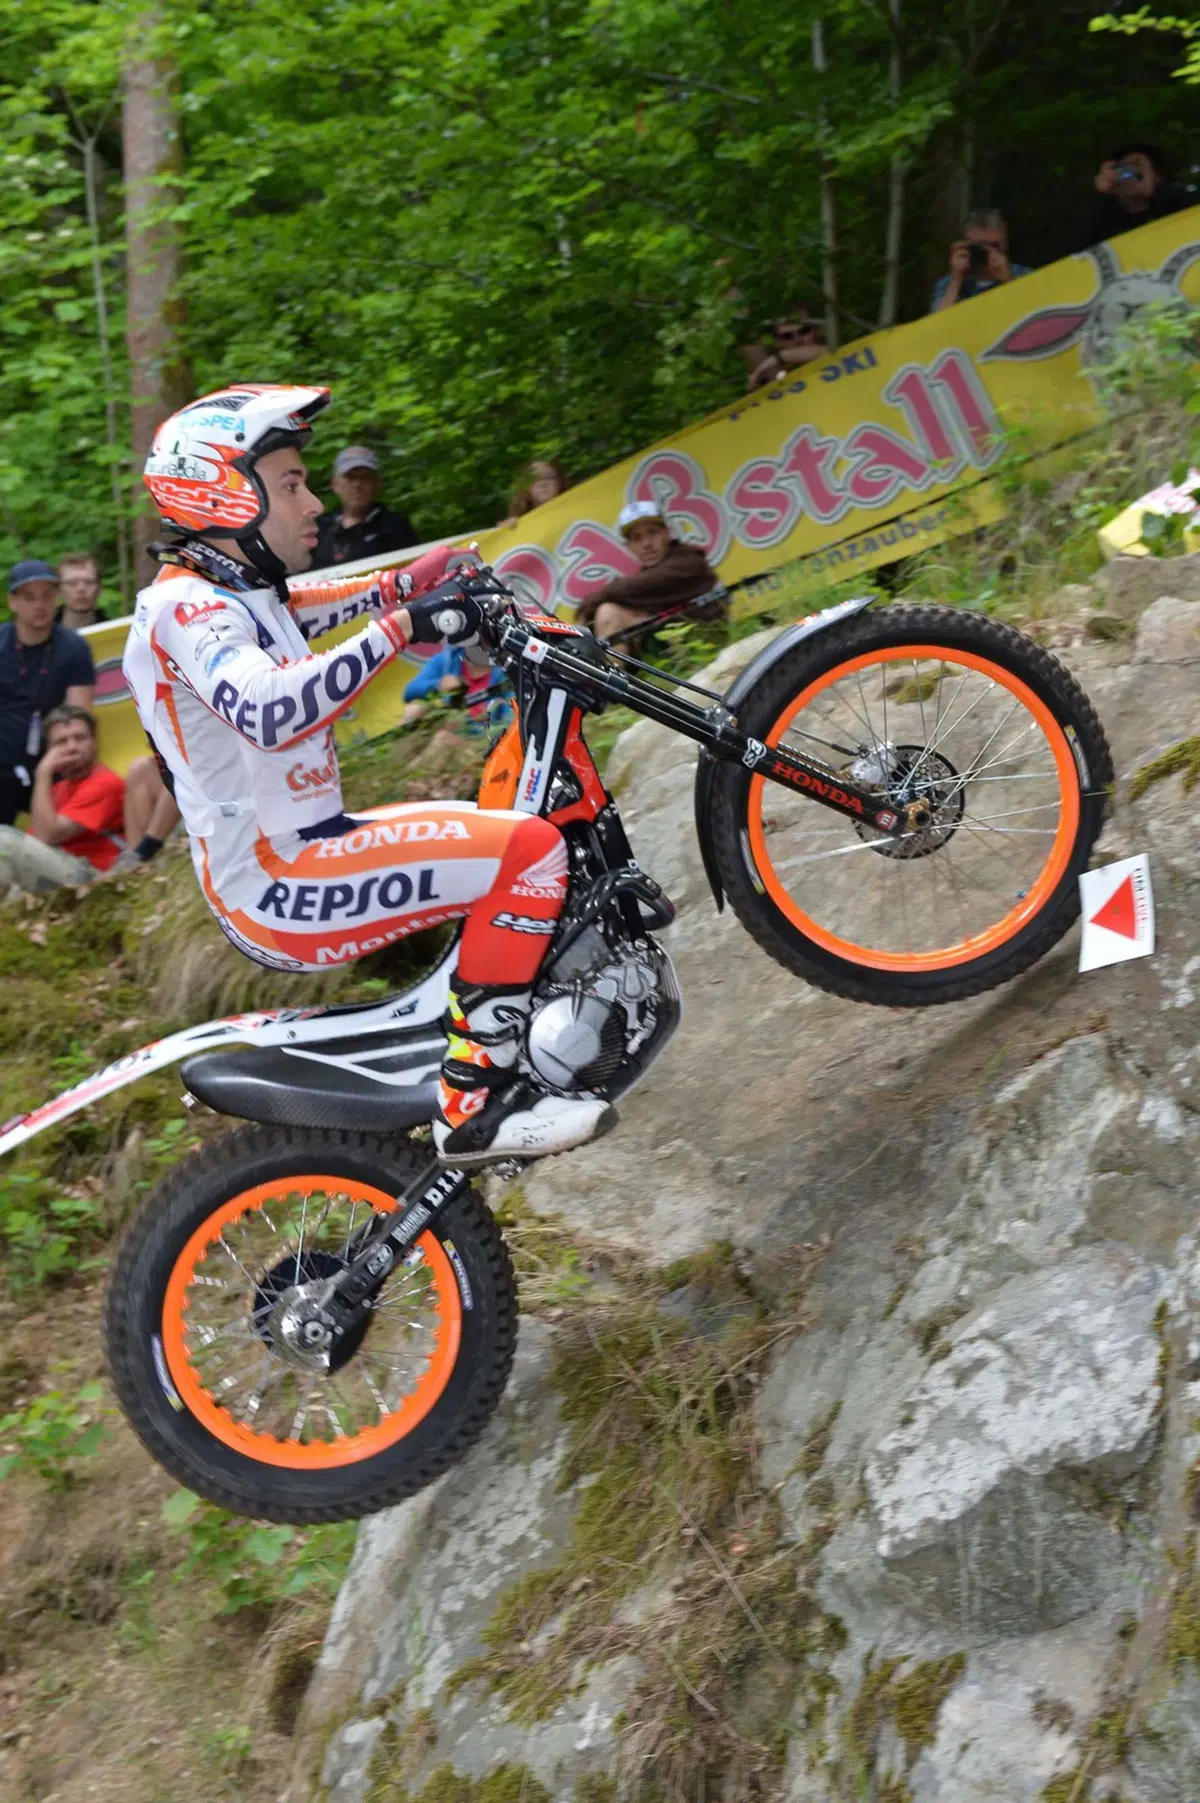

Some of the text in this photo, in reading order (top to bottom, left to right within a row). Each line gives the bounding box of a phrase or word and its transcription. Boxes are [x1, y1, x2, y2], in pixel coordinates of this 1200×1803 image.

[212, 636, 386, 747] REPSOL
[771, 760, 864, 814] HONDA
[314, 820, 472, 859] HONDA
[257, 868, 440, 922] REPSOL
[509, 884, 568, 899] HON
[315, 904, 472, 964] Montes
